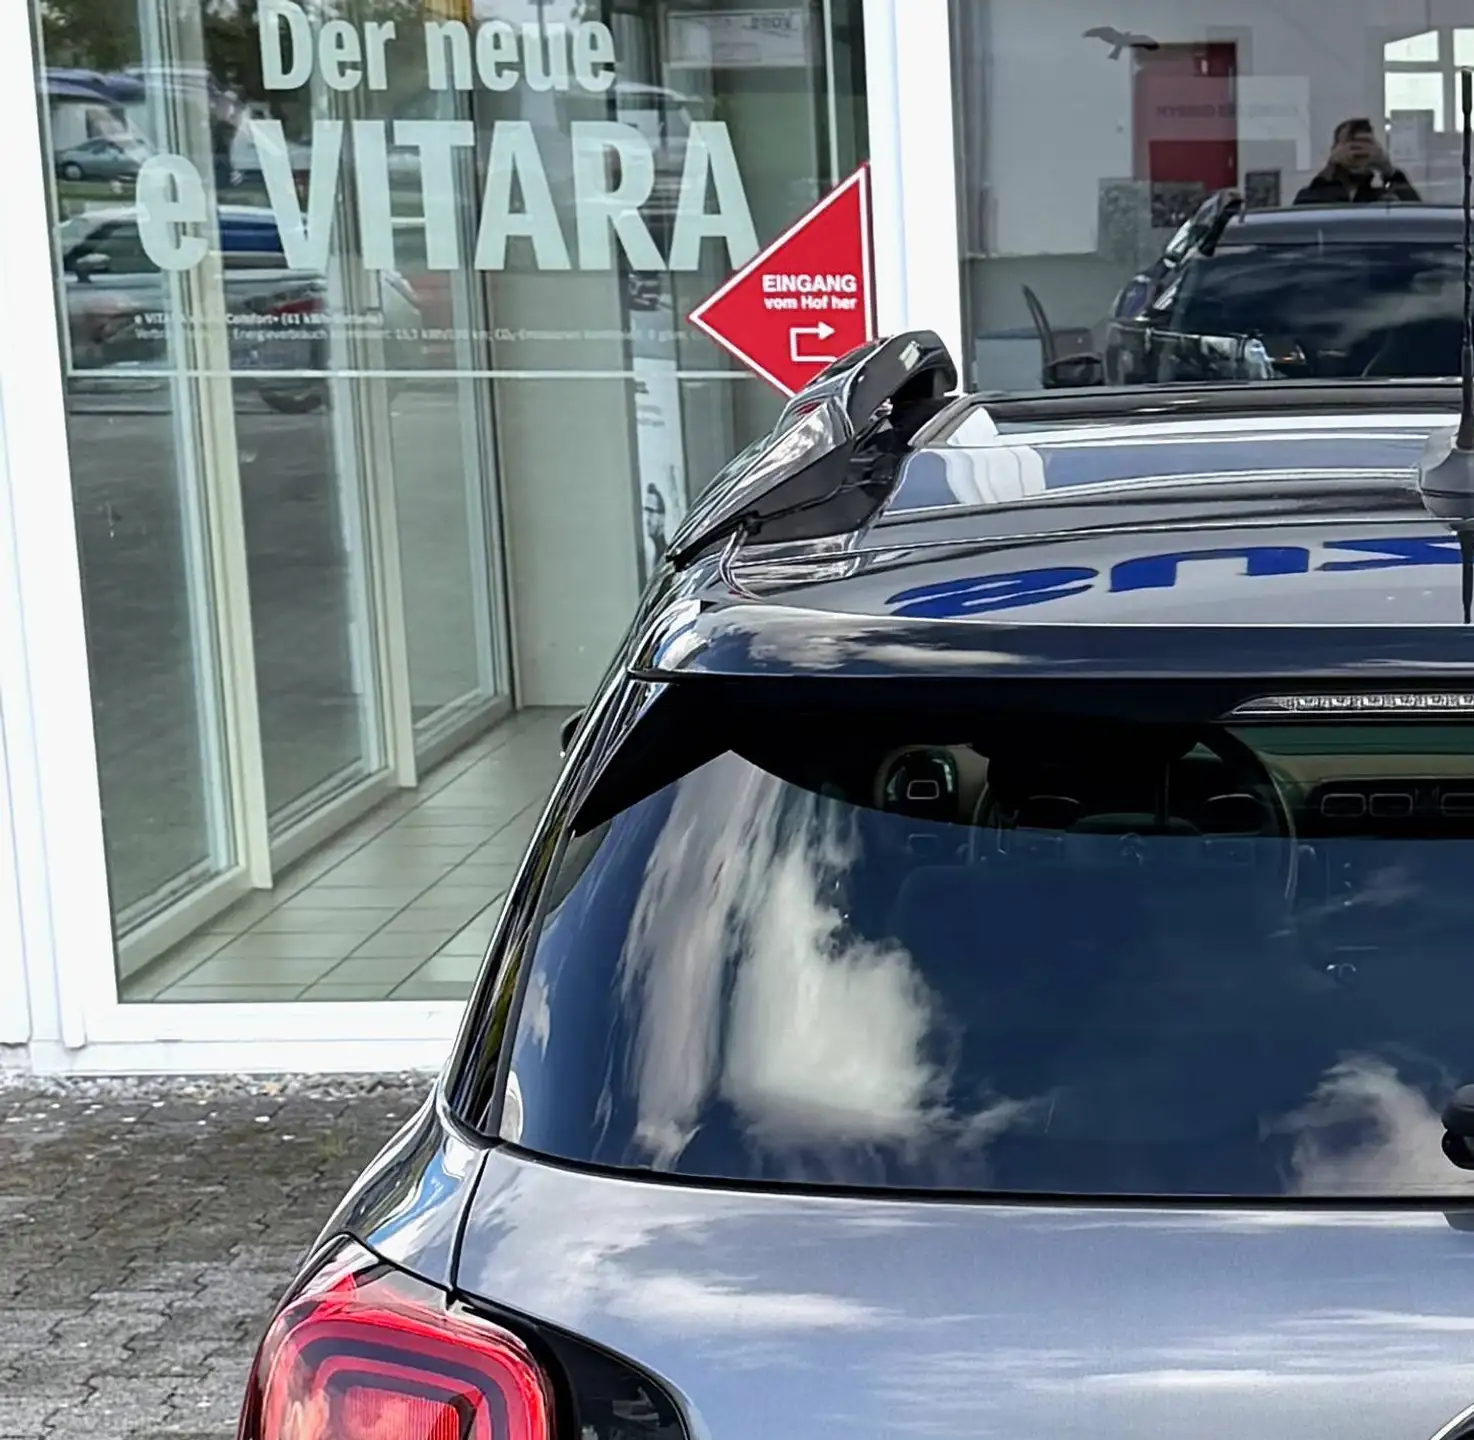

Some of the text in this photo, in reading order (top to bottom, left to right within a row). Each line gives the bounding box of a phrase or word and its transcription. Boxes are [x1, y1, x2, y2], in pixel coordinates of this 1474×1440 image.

[257, 0, 617, 91] Der neue
[136, 119, 761, 272] e VITARA
[762, 274, 857, 293] EINGANG
[764, 295, 857, 310] vom Hof her
